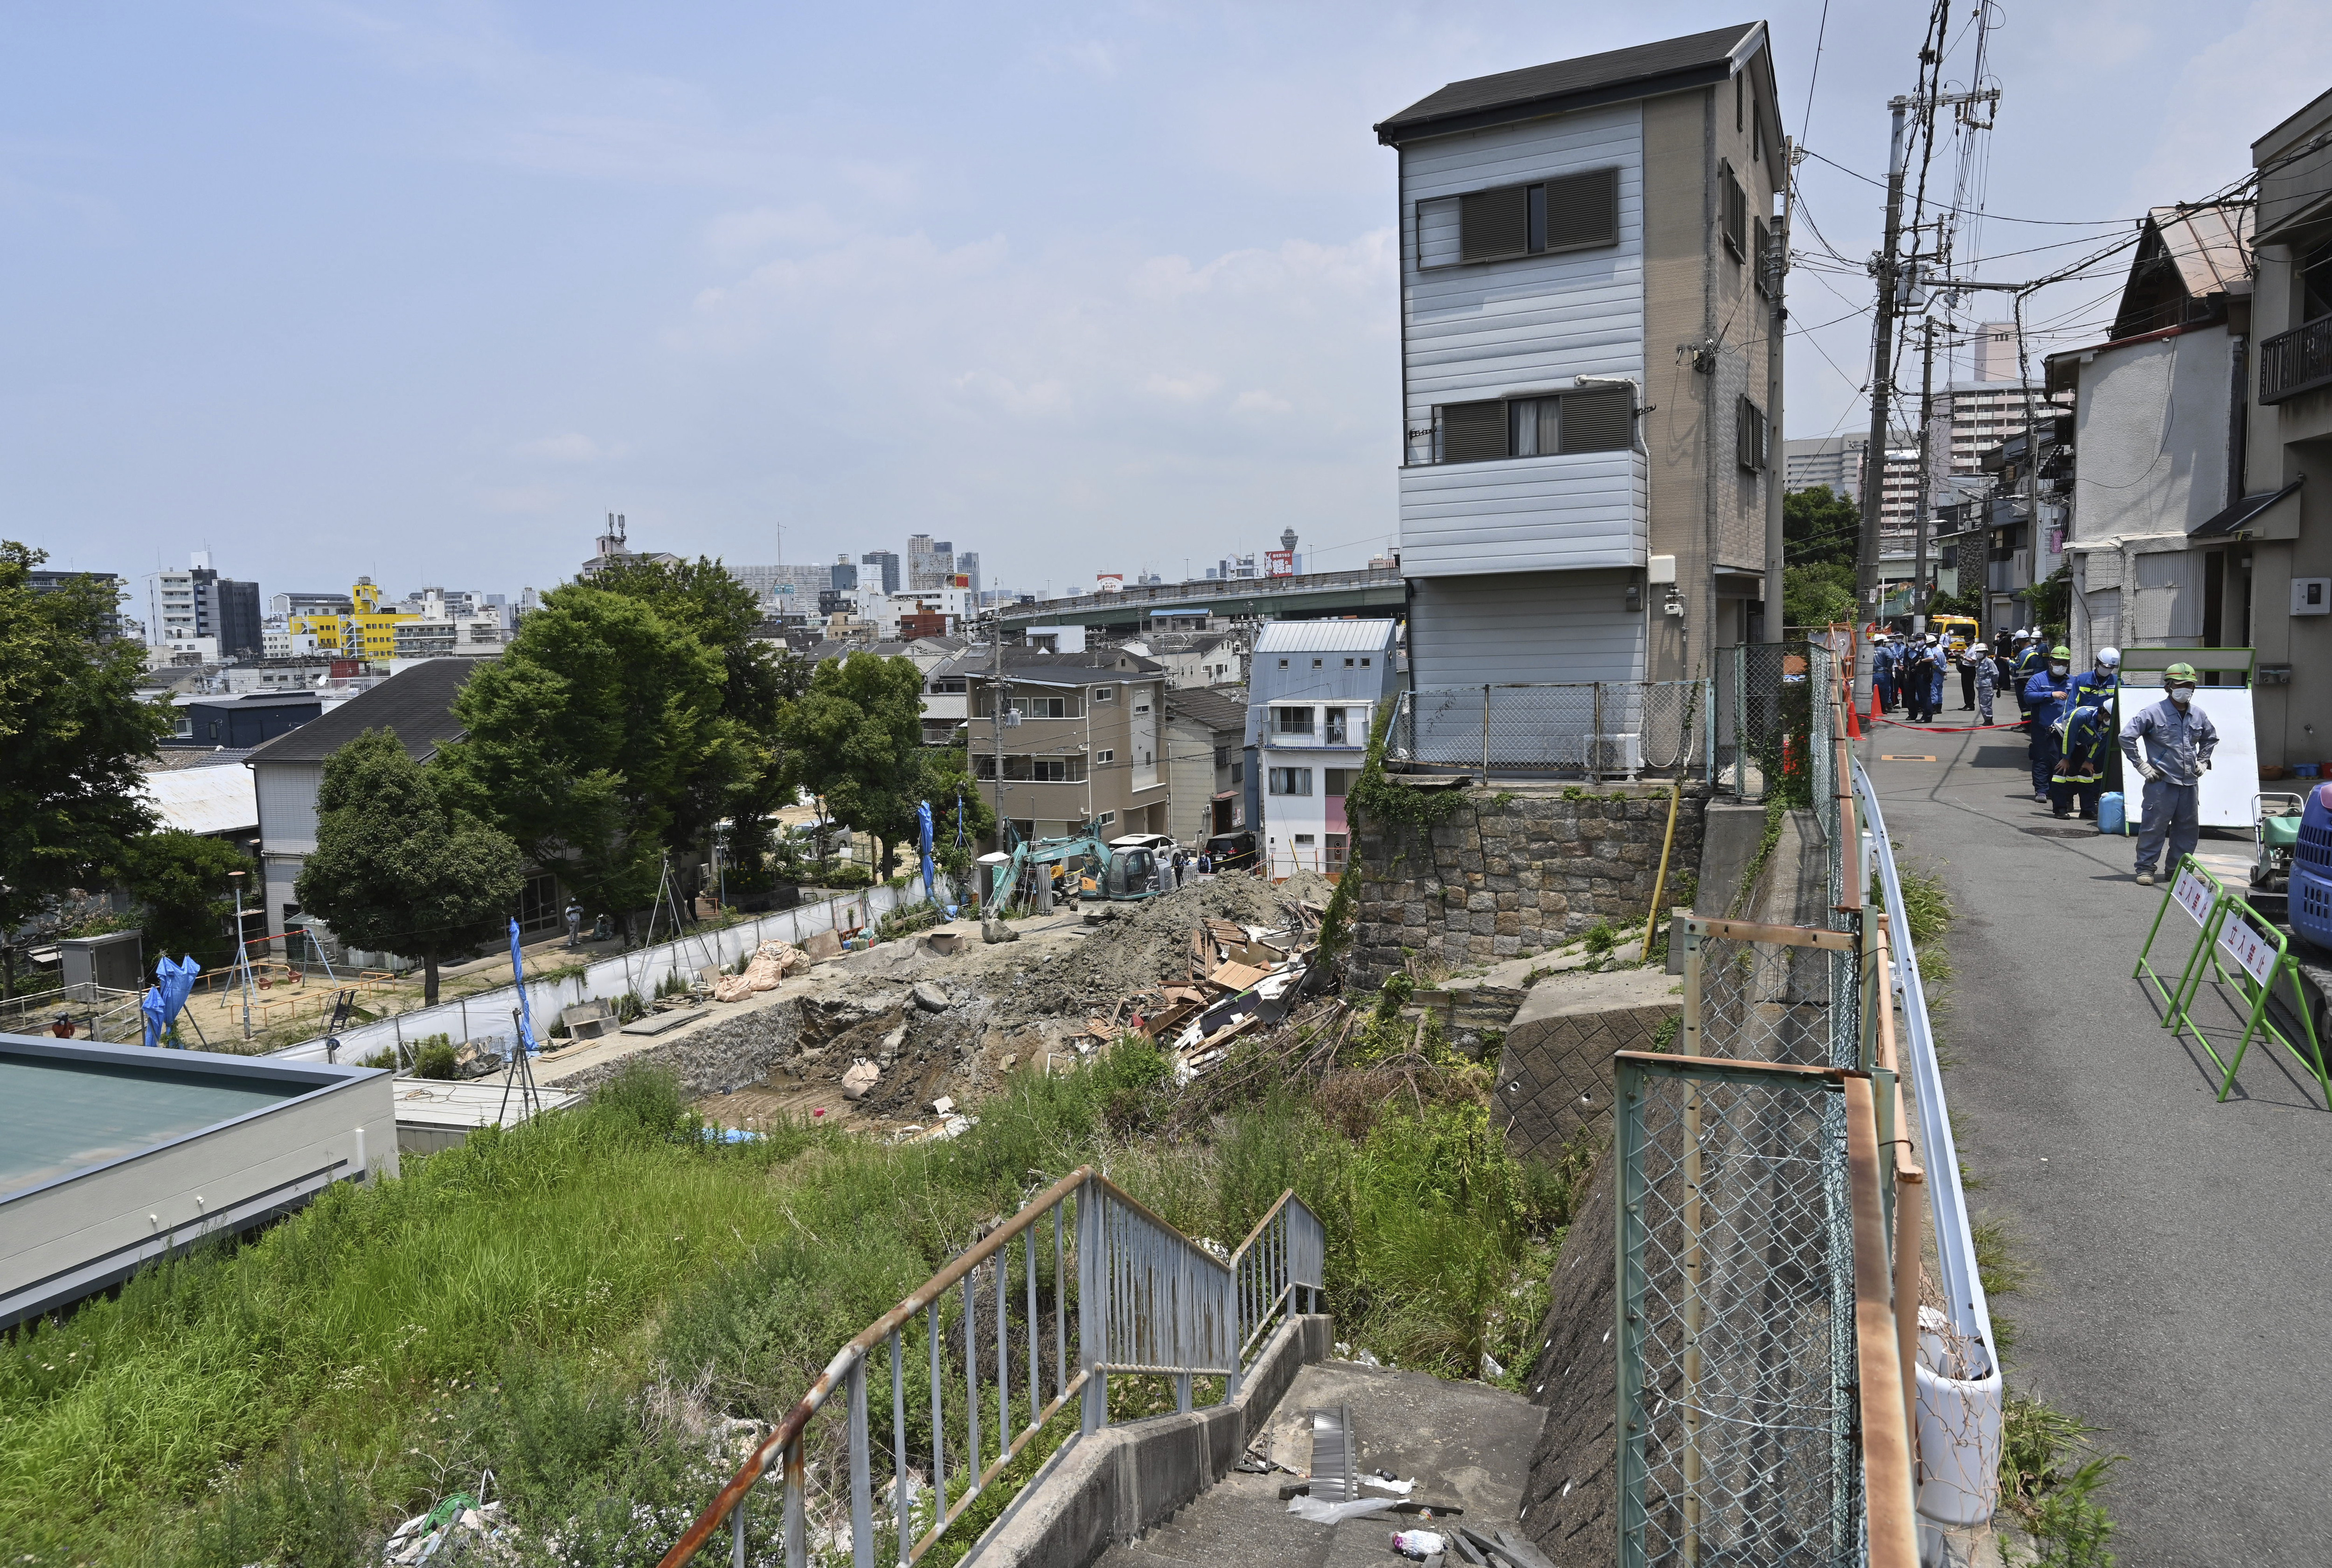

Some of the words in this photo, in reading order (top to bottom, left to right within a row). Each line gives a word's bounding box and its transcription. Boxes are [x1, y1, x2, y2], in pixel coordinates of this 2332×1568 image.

[1272, 559, 1292, 575] 軽の森
[2179, 879, 2208, 918] 立入禁止
[2228, 925, 2265, 975] 立入禁止
